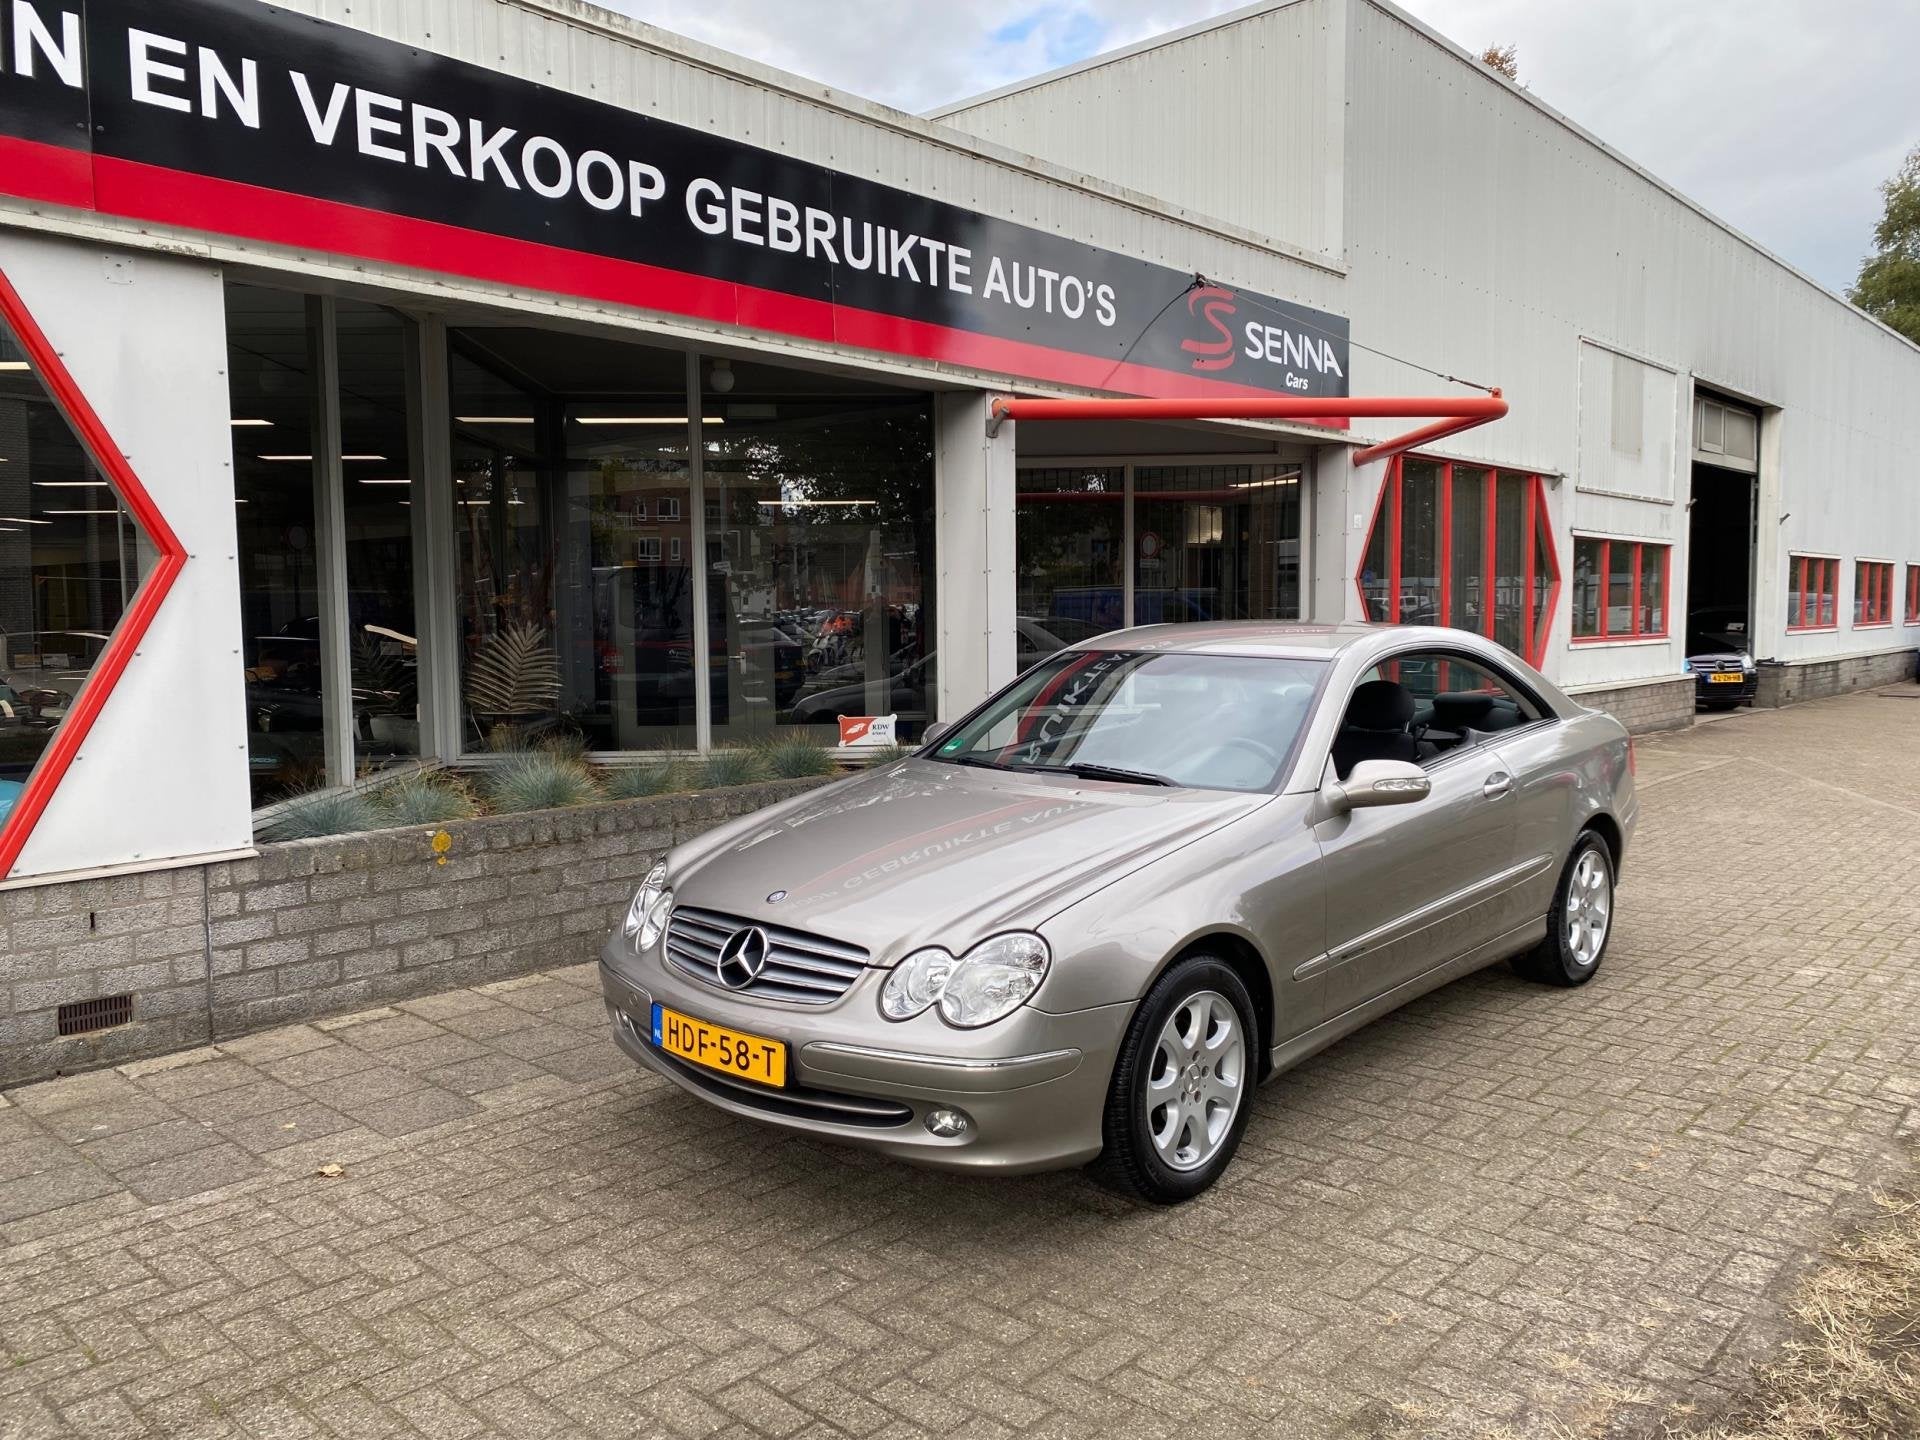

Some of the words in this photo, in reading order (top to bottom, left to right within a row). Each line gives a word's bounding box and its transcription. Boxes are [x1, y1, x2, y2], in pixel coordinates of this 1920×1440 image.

[0, 0, 83, 88] N
[128, 27, 260, 129] EN
[288, 70, 666, 218] VERKOOP
[685, 177, 972, 295] GEBRUIKTE
[983, 256, 1116, 327] AUTO'S
[1245, 322, 1343, 378] SENNA
[1285, 372, 1309, 390] Cars
[872, 723, 890, 731] RDW
[654, 1028, 662, 1040] NL
[667, 1016, 777, 1078] HDF-58-T
